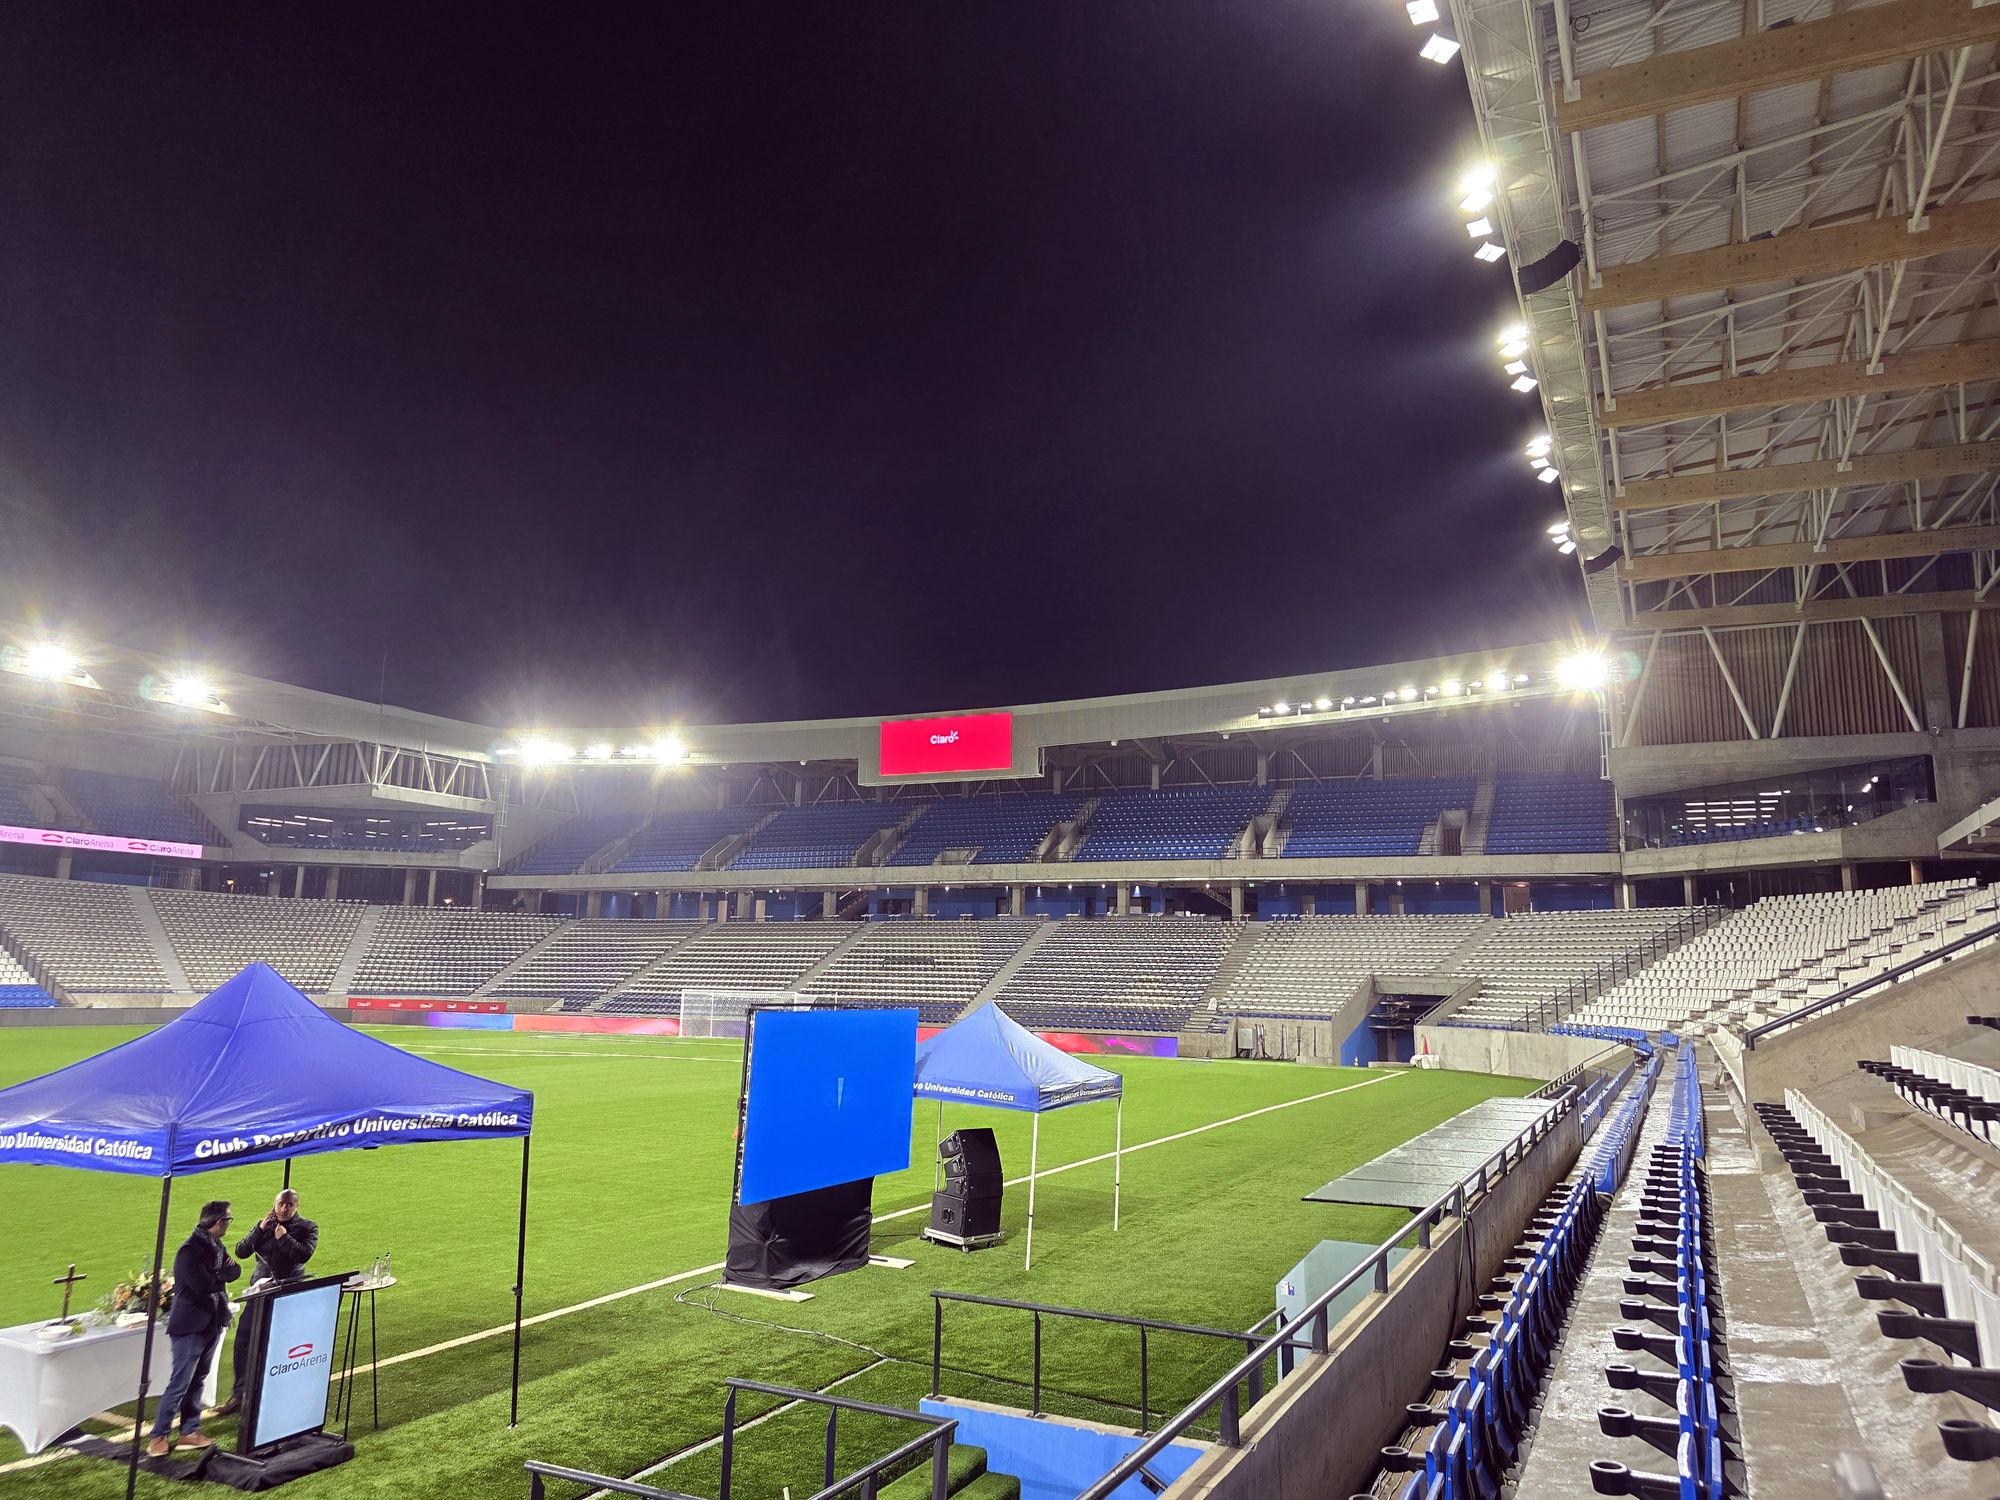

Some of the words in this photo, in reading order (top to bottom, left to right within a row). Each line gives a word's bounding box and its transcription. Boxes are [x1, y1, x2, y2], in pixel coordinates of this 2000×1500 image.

[930, 734, 956, 745] Claro
[924, 1082, 976, 1097] Universidad
[977, 1088, 1015, 1102] Católica
[15, 1131, 94, 1155] Universidad
[95, 1138, 153, 1160] Católica
[195, 1137, 249, 1158] Club
[253, 1122, 350, 1148] Deportivo
[353, 1114, 454, 1134] Universidad
[457, 1111, 518, 1128] Católica
[269, 1353, 328, 1377] ClaroArena
